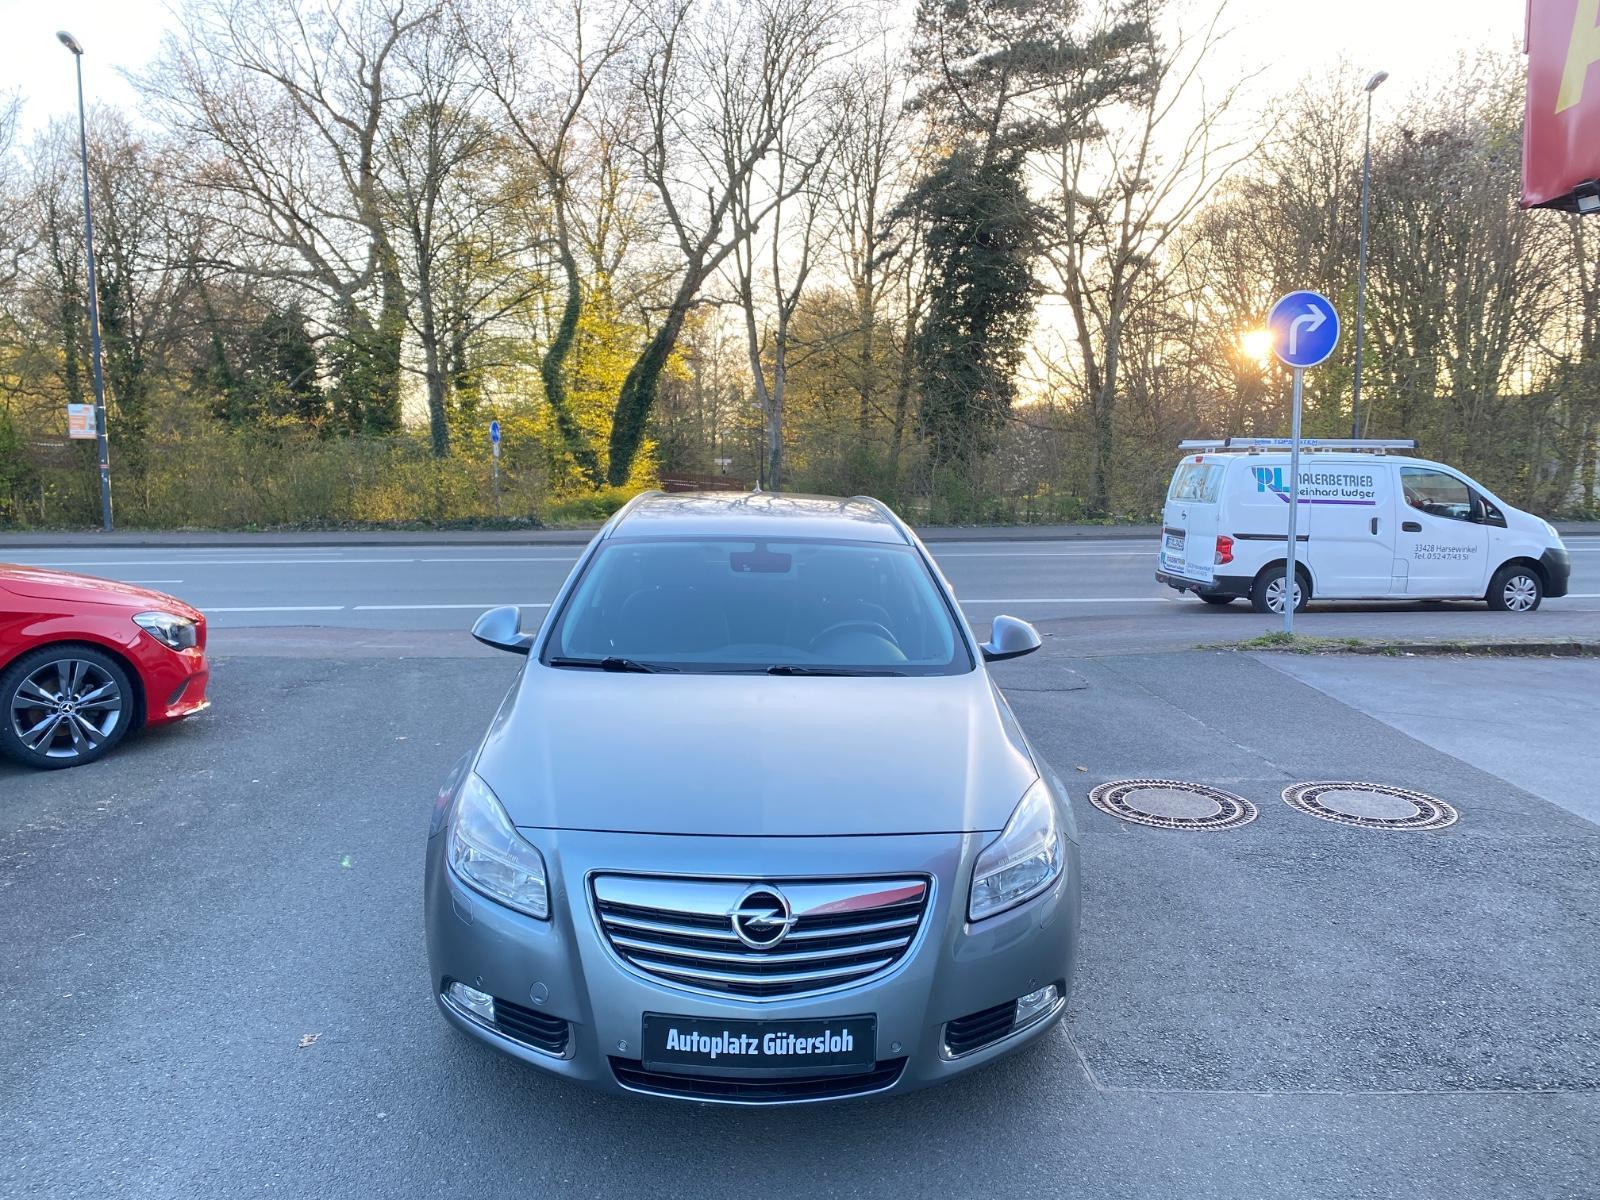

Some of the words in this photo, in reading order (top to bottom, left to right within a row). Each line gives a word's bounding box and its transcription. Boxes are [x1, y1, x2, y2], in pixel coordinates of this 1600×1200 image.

[1297, 488, 1339, 497] einhard
[1415, 544, 1435, 552] 33428
[666, 1028, 759, 1059] Autoplatz
[763, 1029, 854, 1056] Gütersloh
